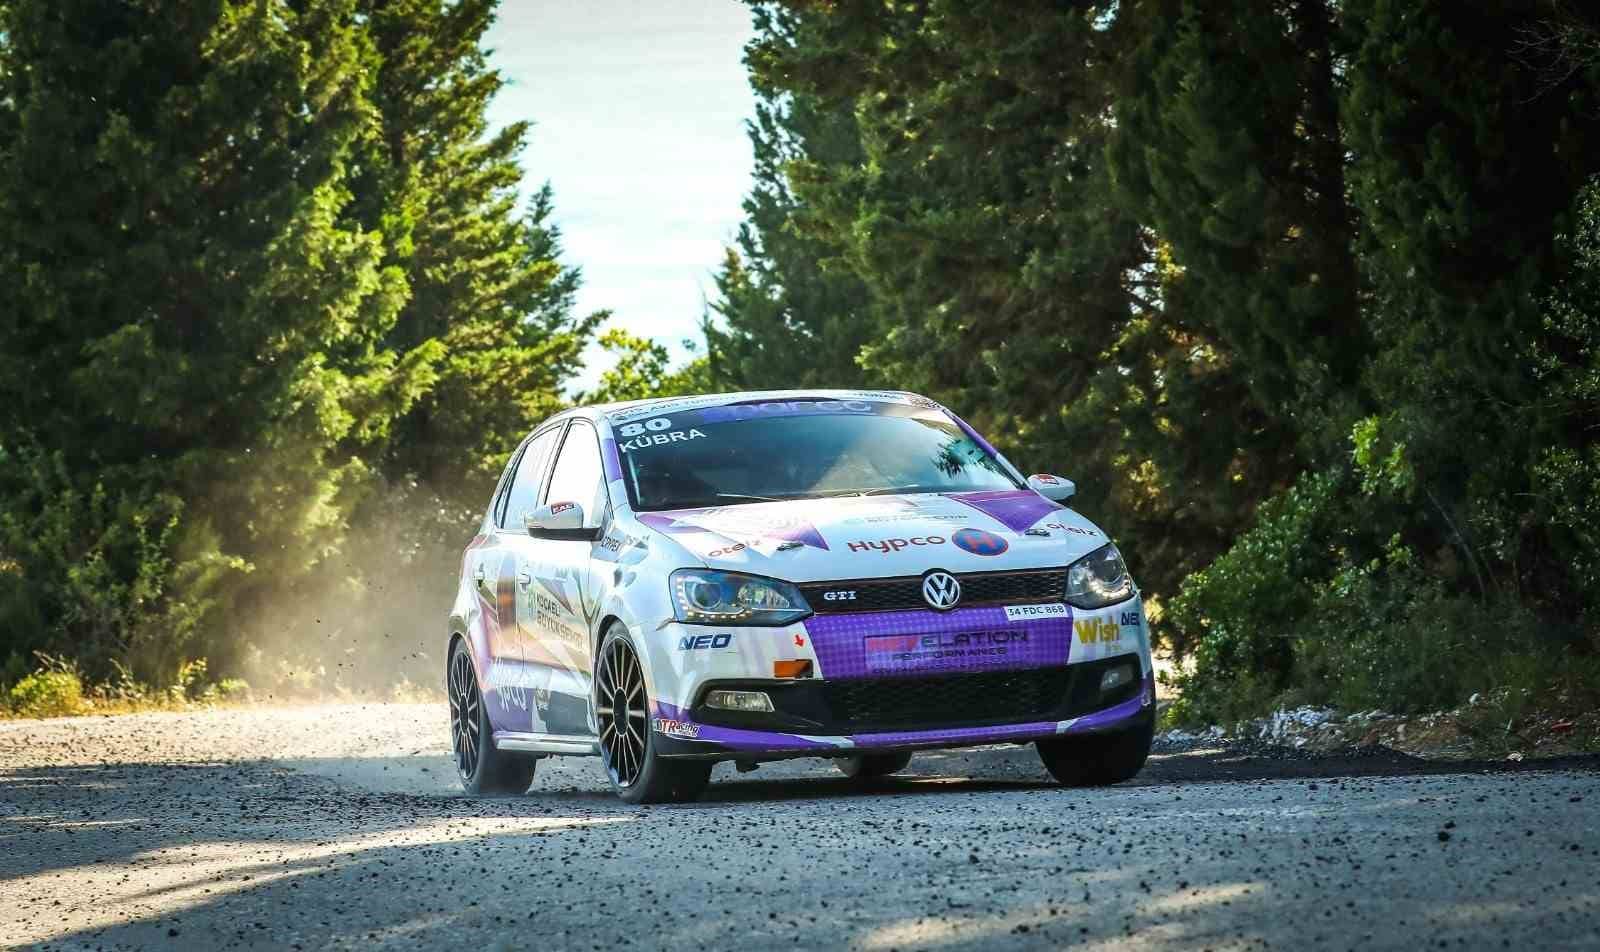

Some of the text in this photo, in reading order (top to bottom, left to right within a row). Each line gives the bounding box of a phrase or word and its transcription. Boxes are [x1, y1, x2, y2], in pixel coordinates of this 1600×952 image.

[620, 418, 672, 437] 80
[619, 428, 707, 453] KÜBRA
[847, 535, 946, 554] Hypco
[823, 590, 857, 601] GTI
[1008, 605, 1065, 616] 34 FDC 868
[1074, 615, 1120, 644] Wish
[679, 633, 732, 650] NEO
